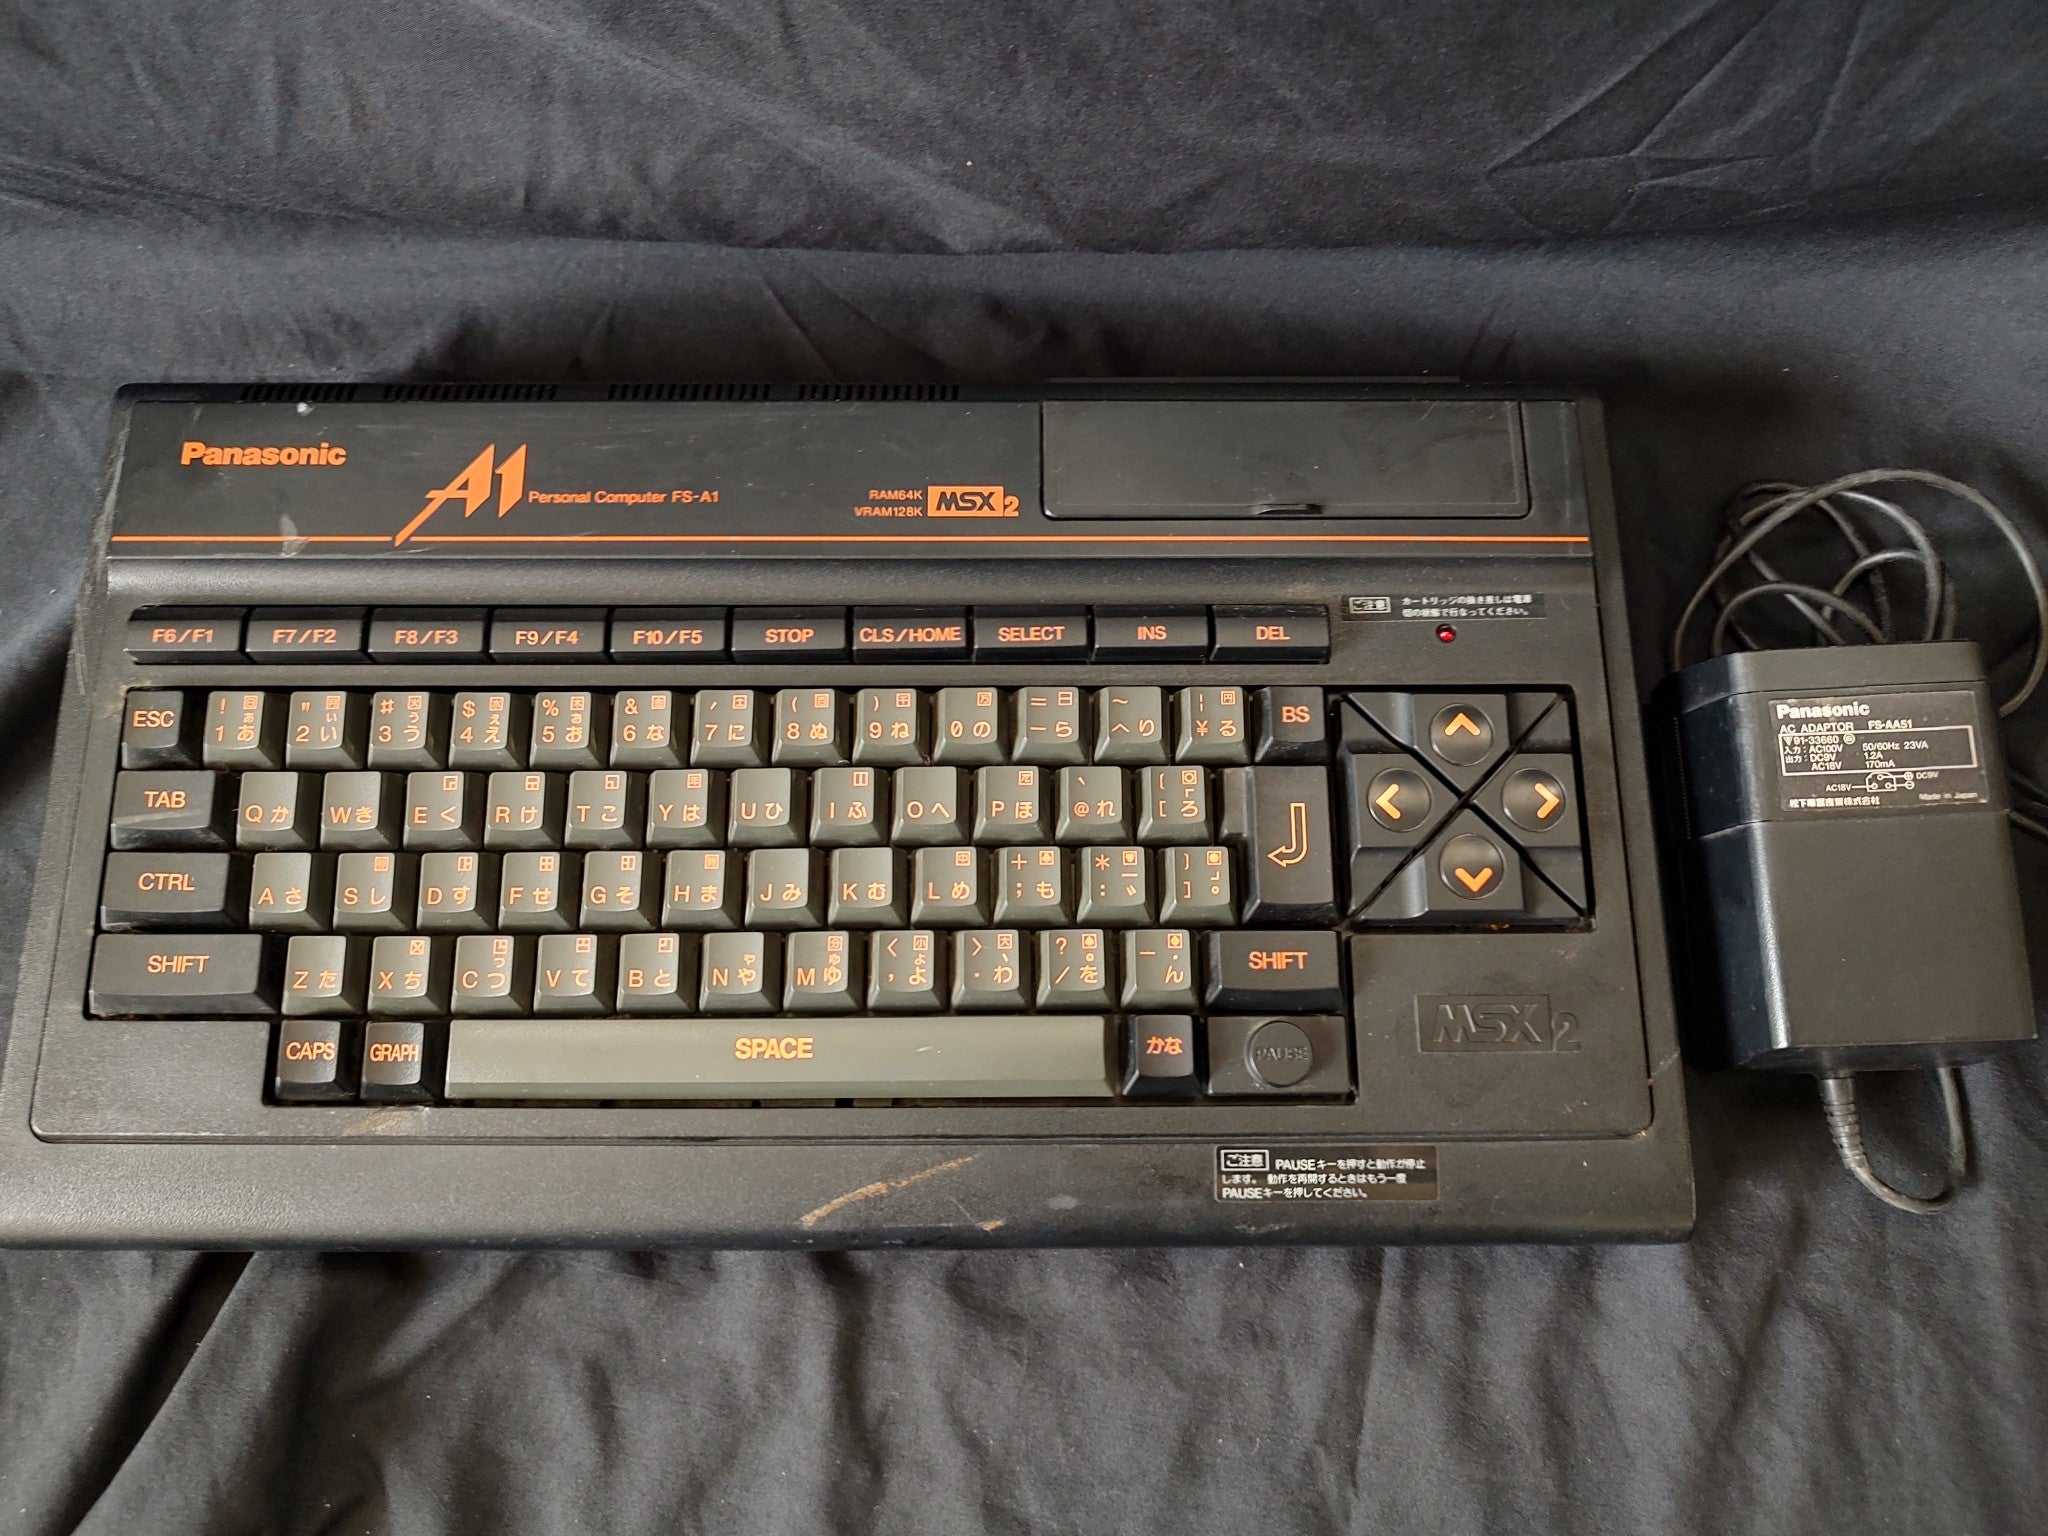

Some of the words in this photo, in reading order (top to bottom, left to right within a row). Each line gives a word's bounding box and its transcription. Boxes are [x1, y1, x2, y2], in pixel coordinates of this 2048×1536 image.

[181, 441, 346, 466] Panasonic
[528, 490, 591, 504] Personal
[594, 489, 667, 504] Computer
[671, 490, 720, 504] FS-A1
[869, 490, 923, 500] RAM64K
[854, 506, 923, 517] VRAM128K
[151, 629, 214, 644] F6/F1
[272, 629, 337, 645] F7/F2
[394, 629, 459, 645] F8/F3
[515, 630, 578, 645] F9/F4
[632, 630, 702, 645] F10/F5
[766, 629, 814, 643] STOP
[860, 628, 961, 643] CLS/HOME
[998, 627, 1065, 642] SELECT
[1137, 627, 1167, 640] INS
[1256, 627, 1290, 640] DEL
[1281, 707, 1310, 723] BS
[1777, 702, 1870, 719] Panasonic
[133, 710, 174, 729] ESC
[1780, 724, 1795, 733] AC
[1801, 722, 1854, 732] ADAPTOR
[1868, 720, 1913, 729] FS-AA51
[215, 726, 225, 741] 1
[236, 725, 255, 741] あ
[296, 727, 310, 742] 2
[319, 726, 338, 742] い
[378, 726, 392, 742] 3
[403, 726, 421, 742] う
[459, 726, 474, 742] 4
[483, 726, 501, 743] え
[541, 725, 555, 742] 5
[565, 725, 584, 743] お
[623, 725, 637, 741] 6
[647, 725, 665, 741] な
[705, 724, 718, 741] 7
[728, 724, 745, 741] に
[787, 722, 800, 739] 8
[810, 722, 828, 740] ぬ
[869, 722, 882, 738] 9
[891, 721, 910, 738] ね
[950, 721, 964, 738] 0
[972, 722, 991, 738] の
[1055, 722, 1072, 738] ら
[1139, 720, 1155, 737] り
[1219, 721, 1237, 737] る
[1809, 745, 1843, 753] AC100V
[1862, 743, 1900, 751] 50/60Hz
[1904, 741, 1929, 750] 23VA
[1810, 754, 1836, 762] DC9V
[1811, 762, 1842, 770] AC18V
[1865, 760, 1895, 768] 170mA
[1826, 783, 1851, 792] AC18V
[144, 791, 186, 809] TAB
[1097, 800, 1115, 817] れ
[245, 806, 263, 824] Q
[271, 806, 290, 823] か
[330, 807, 352, 823] W
[355, 806, 373, 823] き
[414, 807, 428, 824] E
[440, 806, 456, 822] く
[495, 807, 510, 823] R
[521, 806, 538, 823] け
[577, 806, 590, 822] T
[601, 805, 618, 822] こ
[659, 805, 674, 821] Y
[683, 805, 701, 821] は
[741, 803, 757, 819] U
[765, 802, 783, 819] ひ
[829, 802, 836, 819] I
[848, 802, 867, 819] ふ
[907, 801, 923, 818] O
[931, 802, 950, 817] へ
[991, 801, 1005, 817] P
[1015, 801, 1033, 818] ほ
[1181, 801, 1199, 817] ろ
[138, 873, 195, 892] CTRL
[843, 883, 858, 900] K
[868, 882, 887, 900] む
[928, 882, 940, 900] L
[951, 881, 971, 900] め
[1036, 881, 1054, 900] も
[258, 888, 274, 904] A
[285, 888, 301, 904] さ
[343, 887, 358, 904] S
[370, 887, 386, 904] し
[427, 888, 442, 904] D
[453, 886, 470, 904] す
[509, 888, 523, 904] F
[533, 887, 551, 904] せ
[590, 886, 607, 904] G
[616, 886, 634, 904] そ
[674, 885, 690, 902] H
[701, 885, 718, 902] ま
[760, 884, 772, 901] J
[782, 883, 801, 901] み
[147, 955, 209, 974] SHIFT
[1248, 951, 1308, 971] SHIFT
[293, 971, 308, 988] Z
[318, 971, 337, 989] た
[378, 971, 394, 989] X
[404, 971, 422, 989] ち
[462, 971, 478, 988] C
[487, 972, 506, 989] つ
[547, 970, 561, 987] V
[572, 970, 589, 987] て
[628, 970, 644, 987] B
[654, 969, 671, 986] と
[712, 969, 729, 986] N
[738, 967, 756, 986] や
[797, 968, 815, 985] M
[823, 966, 842, 985] ゆ
[909, 966, 927, 986] よ
[993, 966, 1012, 983] わ
[1079, 965, 1098, 984] を
[1165, 966, 1183, 983] ん
[286, 1042, 335, 1060] CAPS
[370, 1043, 419, 1062] GRAPH
[735, 1037, 814, 1059] SPACE
[1147, 1037, 1182, 1055] かな
[1256, 1047, 1309, 1061] PAUSE
[1226, 1154, 1263, 1167] ご注意
